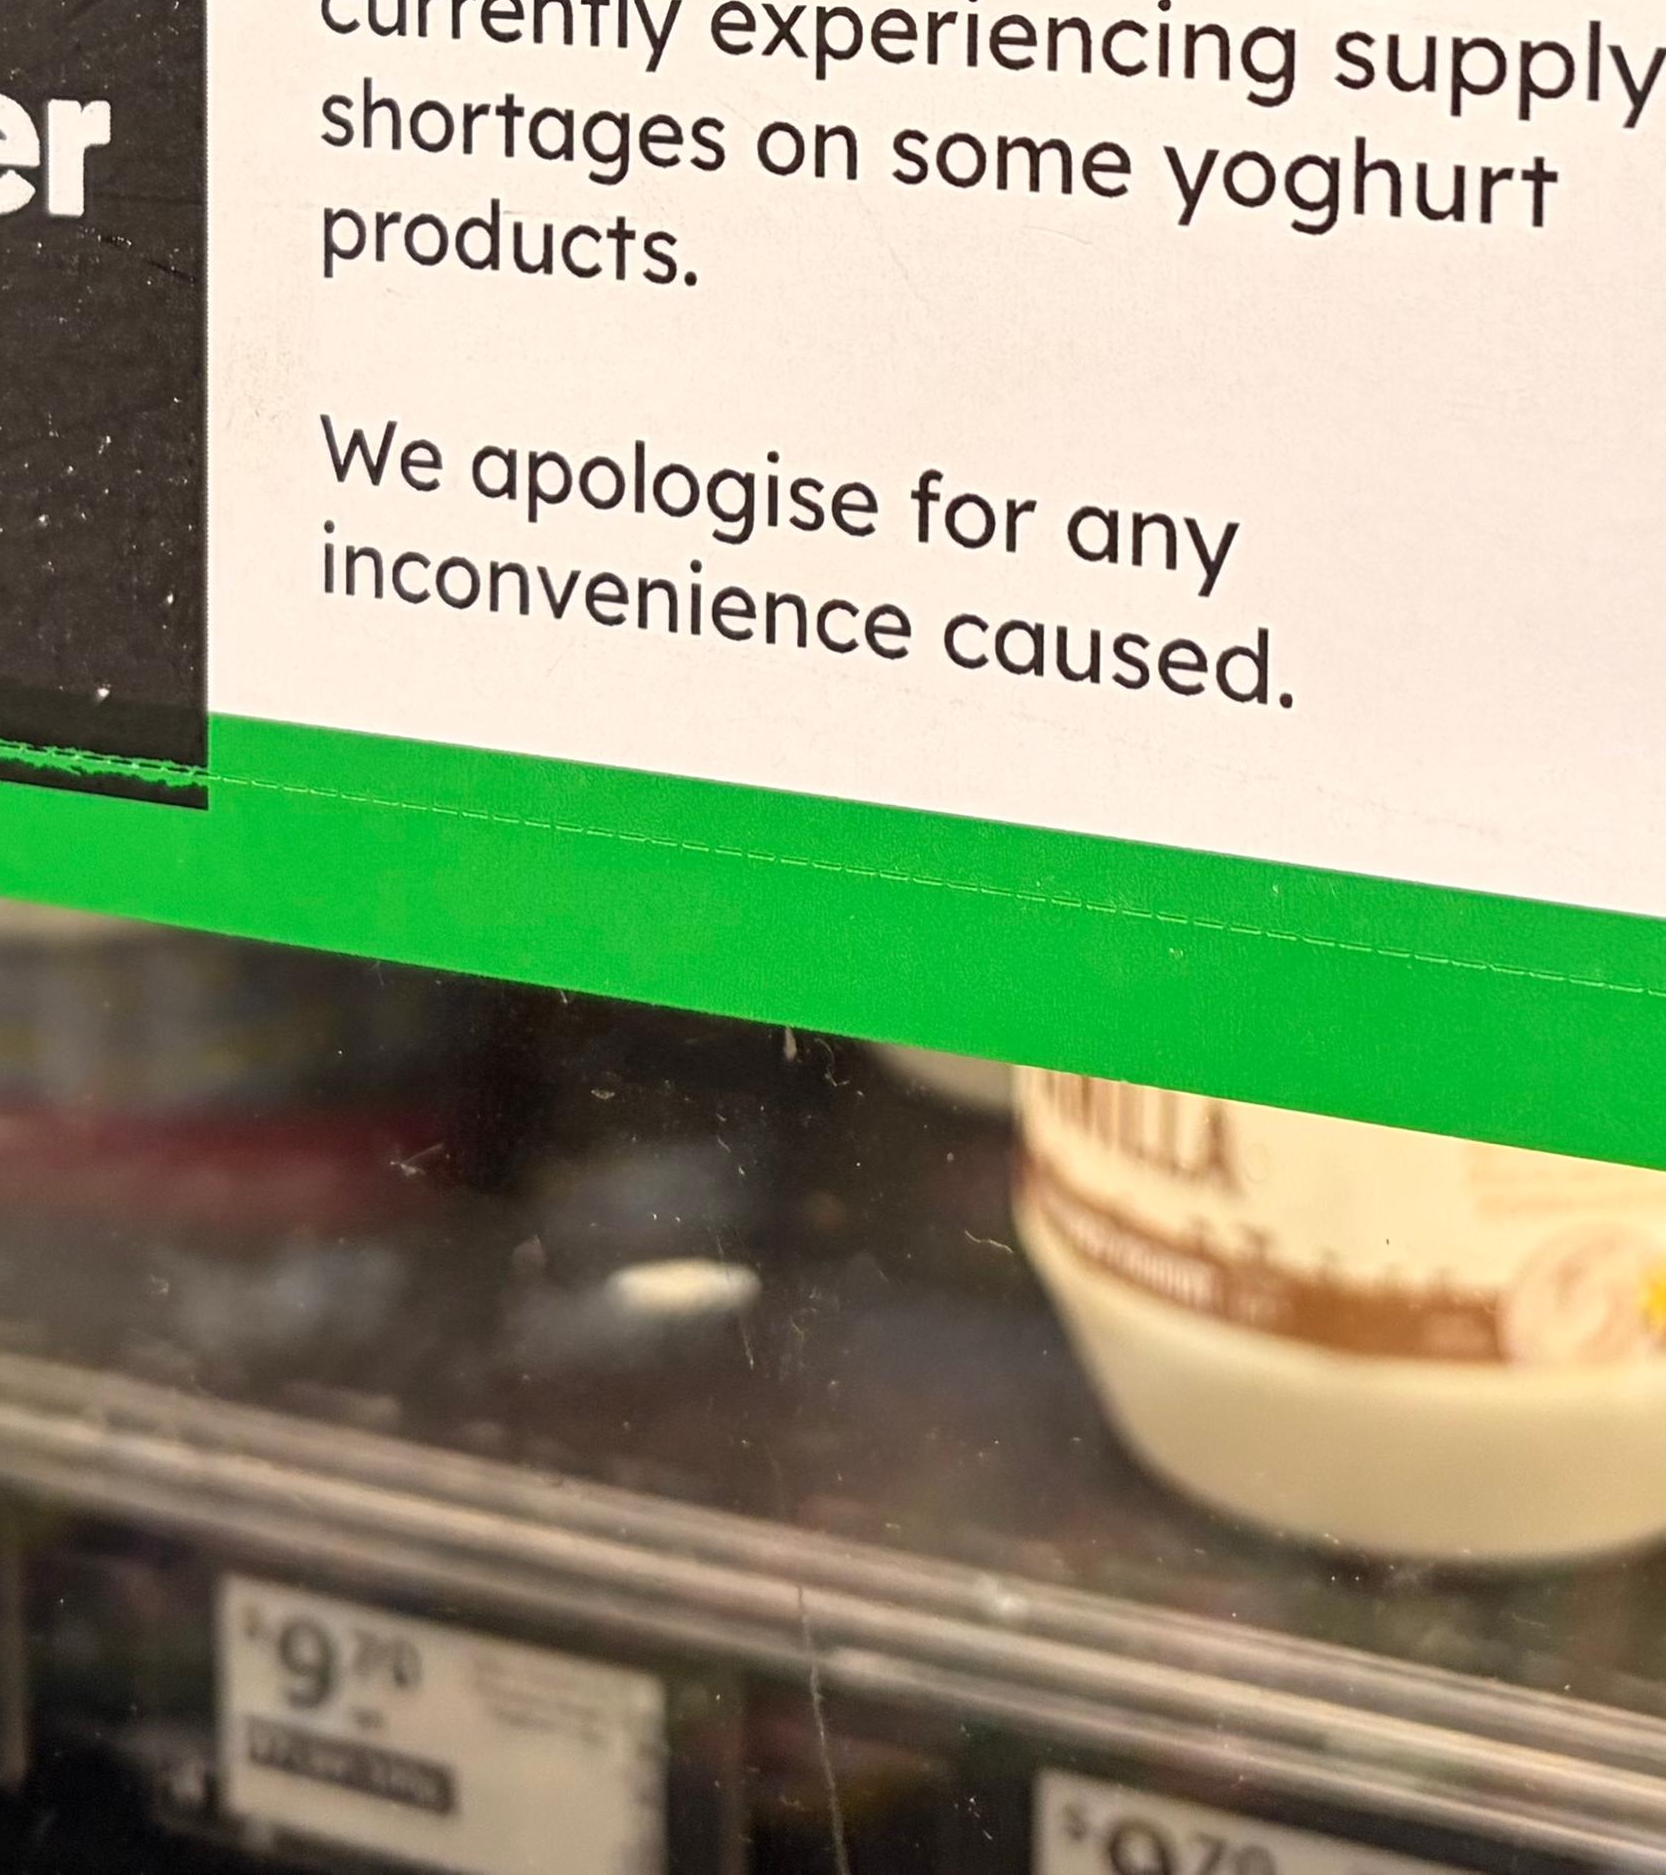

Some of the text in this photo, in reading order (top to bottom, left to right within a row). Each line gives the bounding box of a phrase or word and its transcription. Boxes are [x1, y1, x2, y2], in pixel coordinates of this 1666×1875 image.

[321, 77, 1559, 236] shortages on some yoghurt
[323, 198, 698, 287] products.
[320, 414, 1240, 598] We apologise for any
[323, 520, 1294, 709] inconvenience caused.
